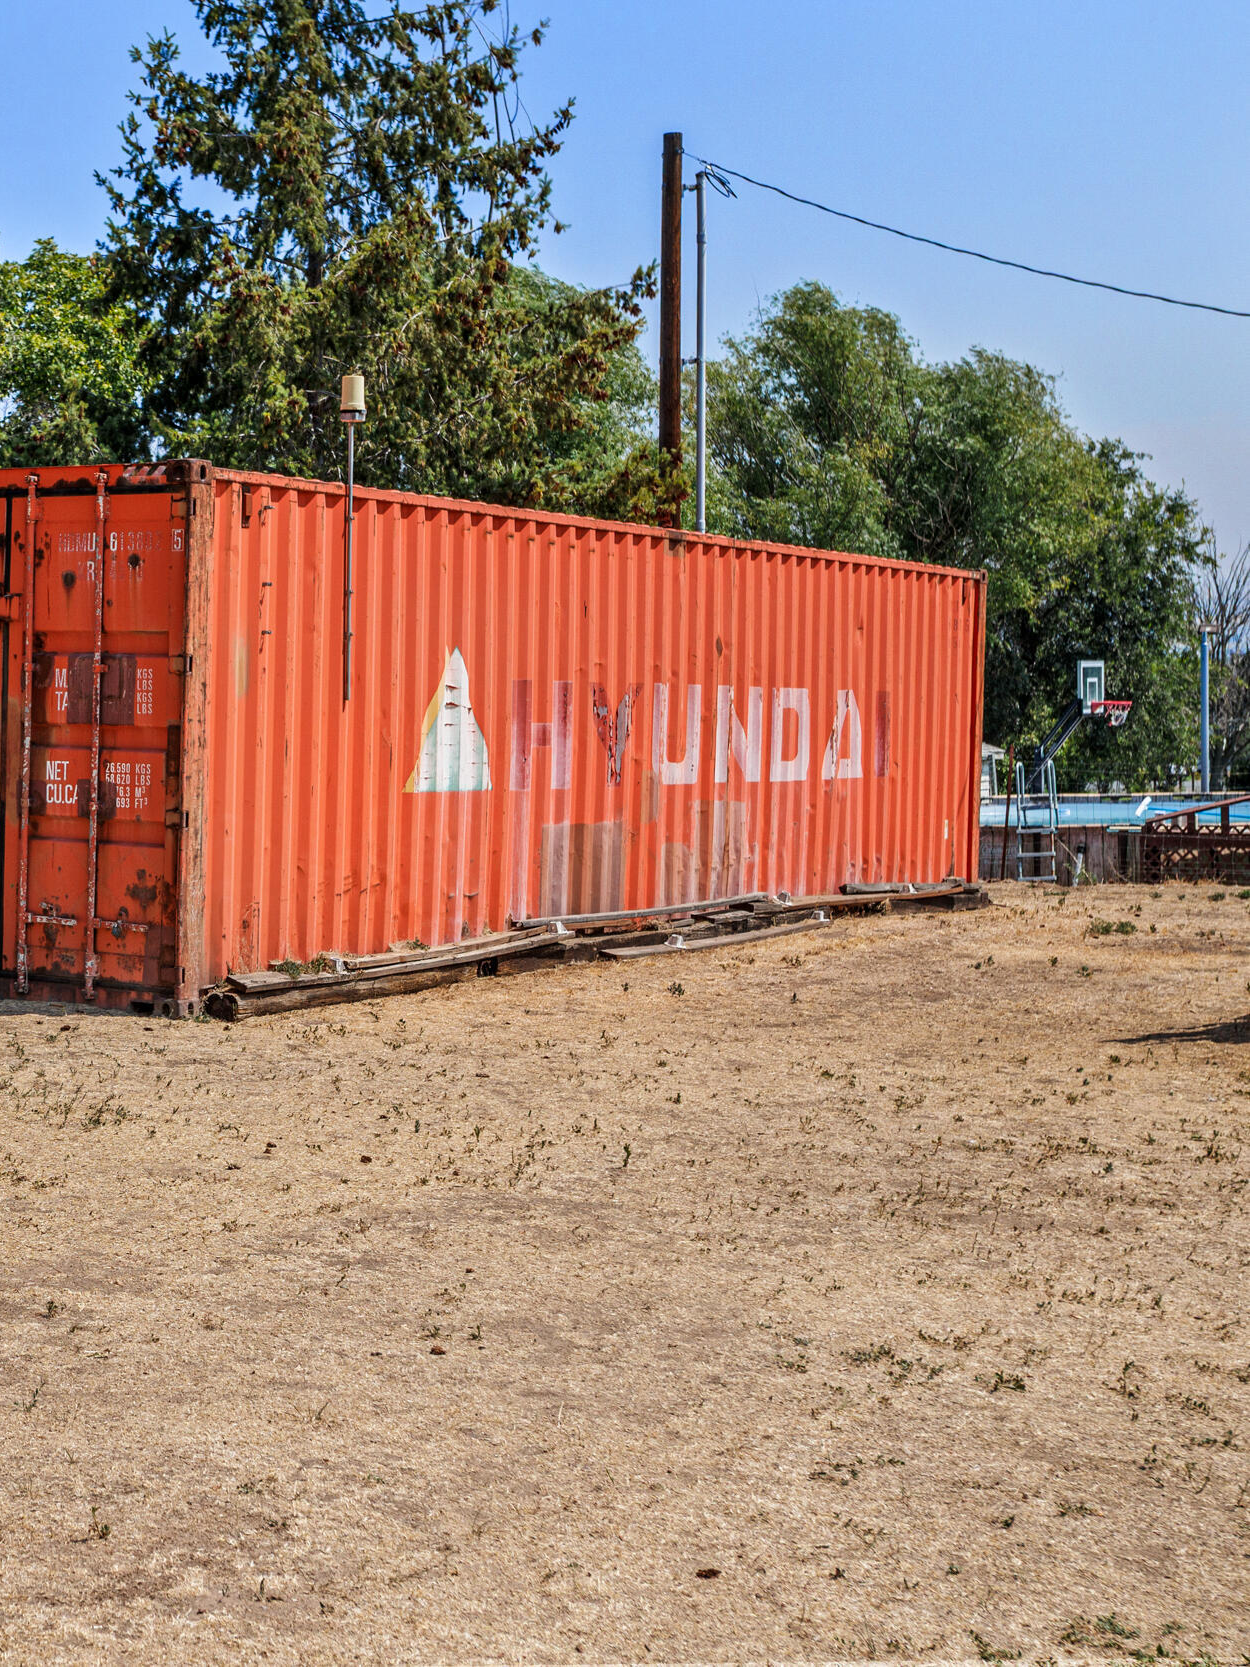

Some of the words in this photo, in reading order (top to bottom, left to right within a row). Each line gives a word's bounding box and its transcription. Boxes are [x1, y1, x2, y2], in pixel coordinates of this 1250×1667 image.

[173, 529, 182, 550] 5
[137, 668, 153, 679] KGS
[137, 680, 153, 690] LBS
[137, 692, 153, 703] KGS
[137, 704, 153, 714] LBS
[509, 680, 890, 791] HYUNDAI
[46, 761, 69, 780] NET
[135, 763, 151, 775] KGS
[135, 775, 151, 786] LBS
